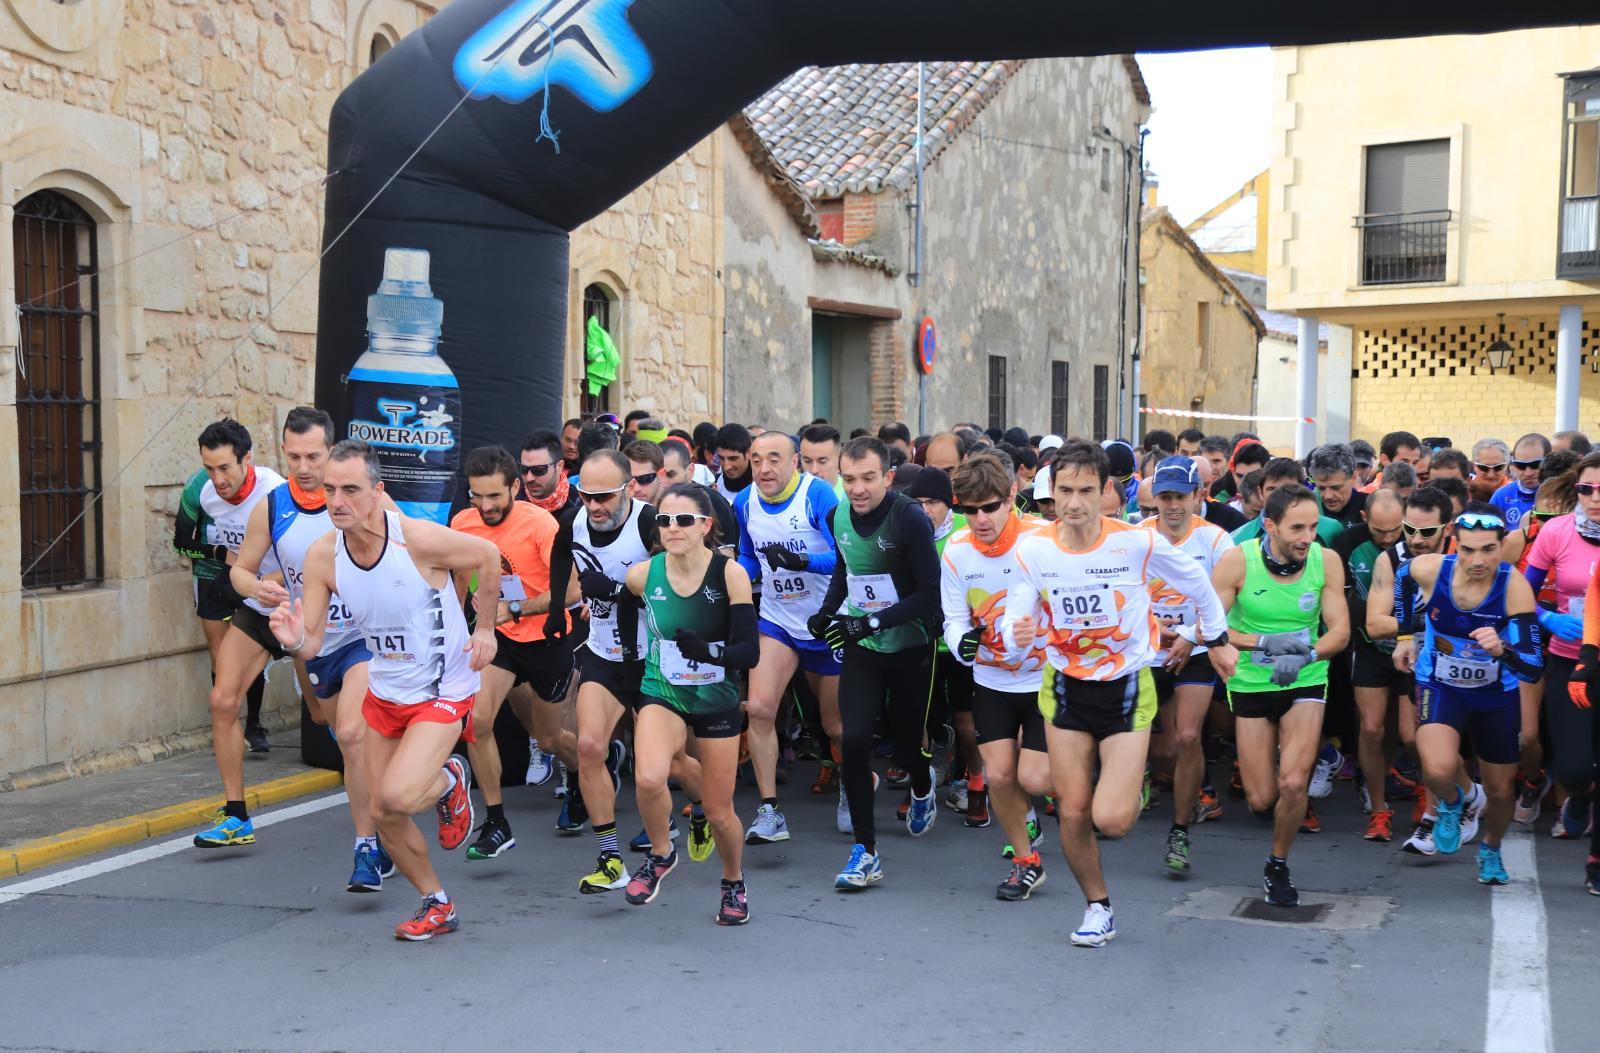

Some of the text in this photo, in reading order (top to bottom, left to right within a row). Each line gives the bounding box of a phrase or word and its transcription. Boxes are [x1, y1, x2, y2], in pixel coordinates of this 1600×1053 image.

[773, 577, 805, 593] 649
[864, 585, 876, 600] 8
[1062, 594, 1102, 616] 602
[370, 635, 406, 652] 747
[687, 659, 699, 672] 4
[1449, 665, 1486, 680] 300
